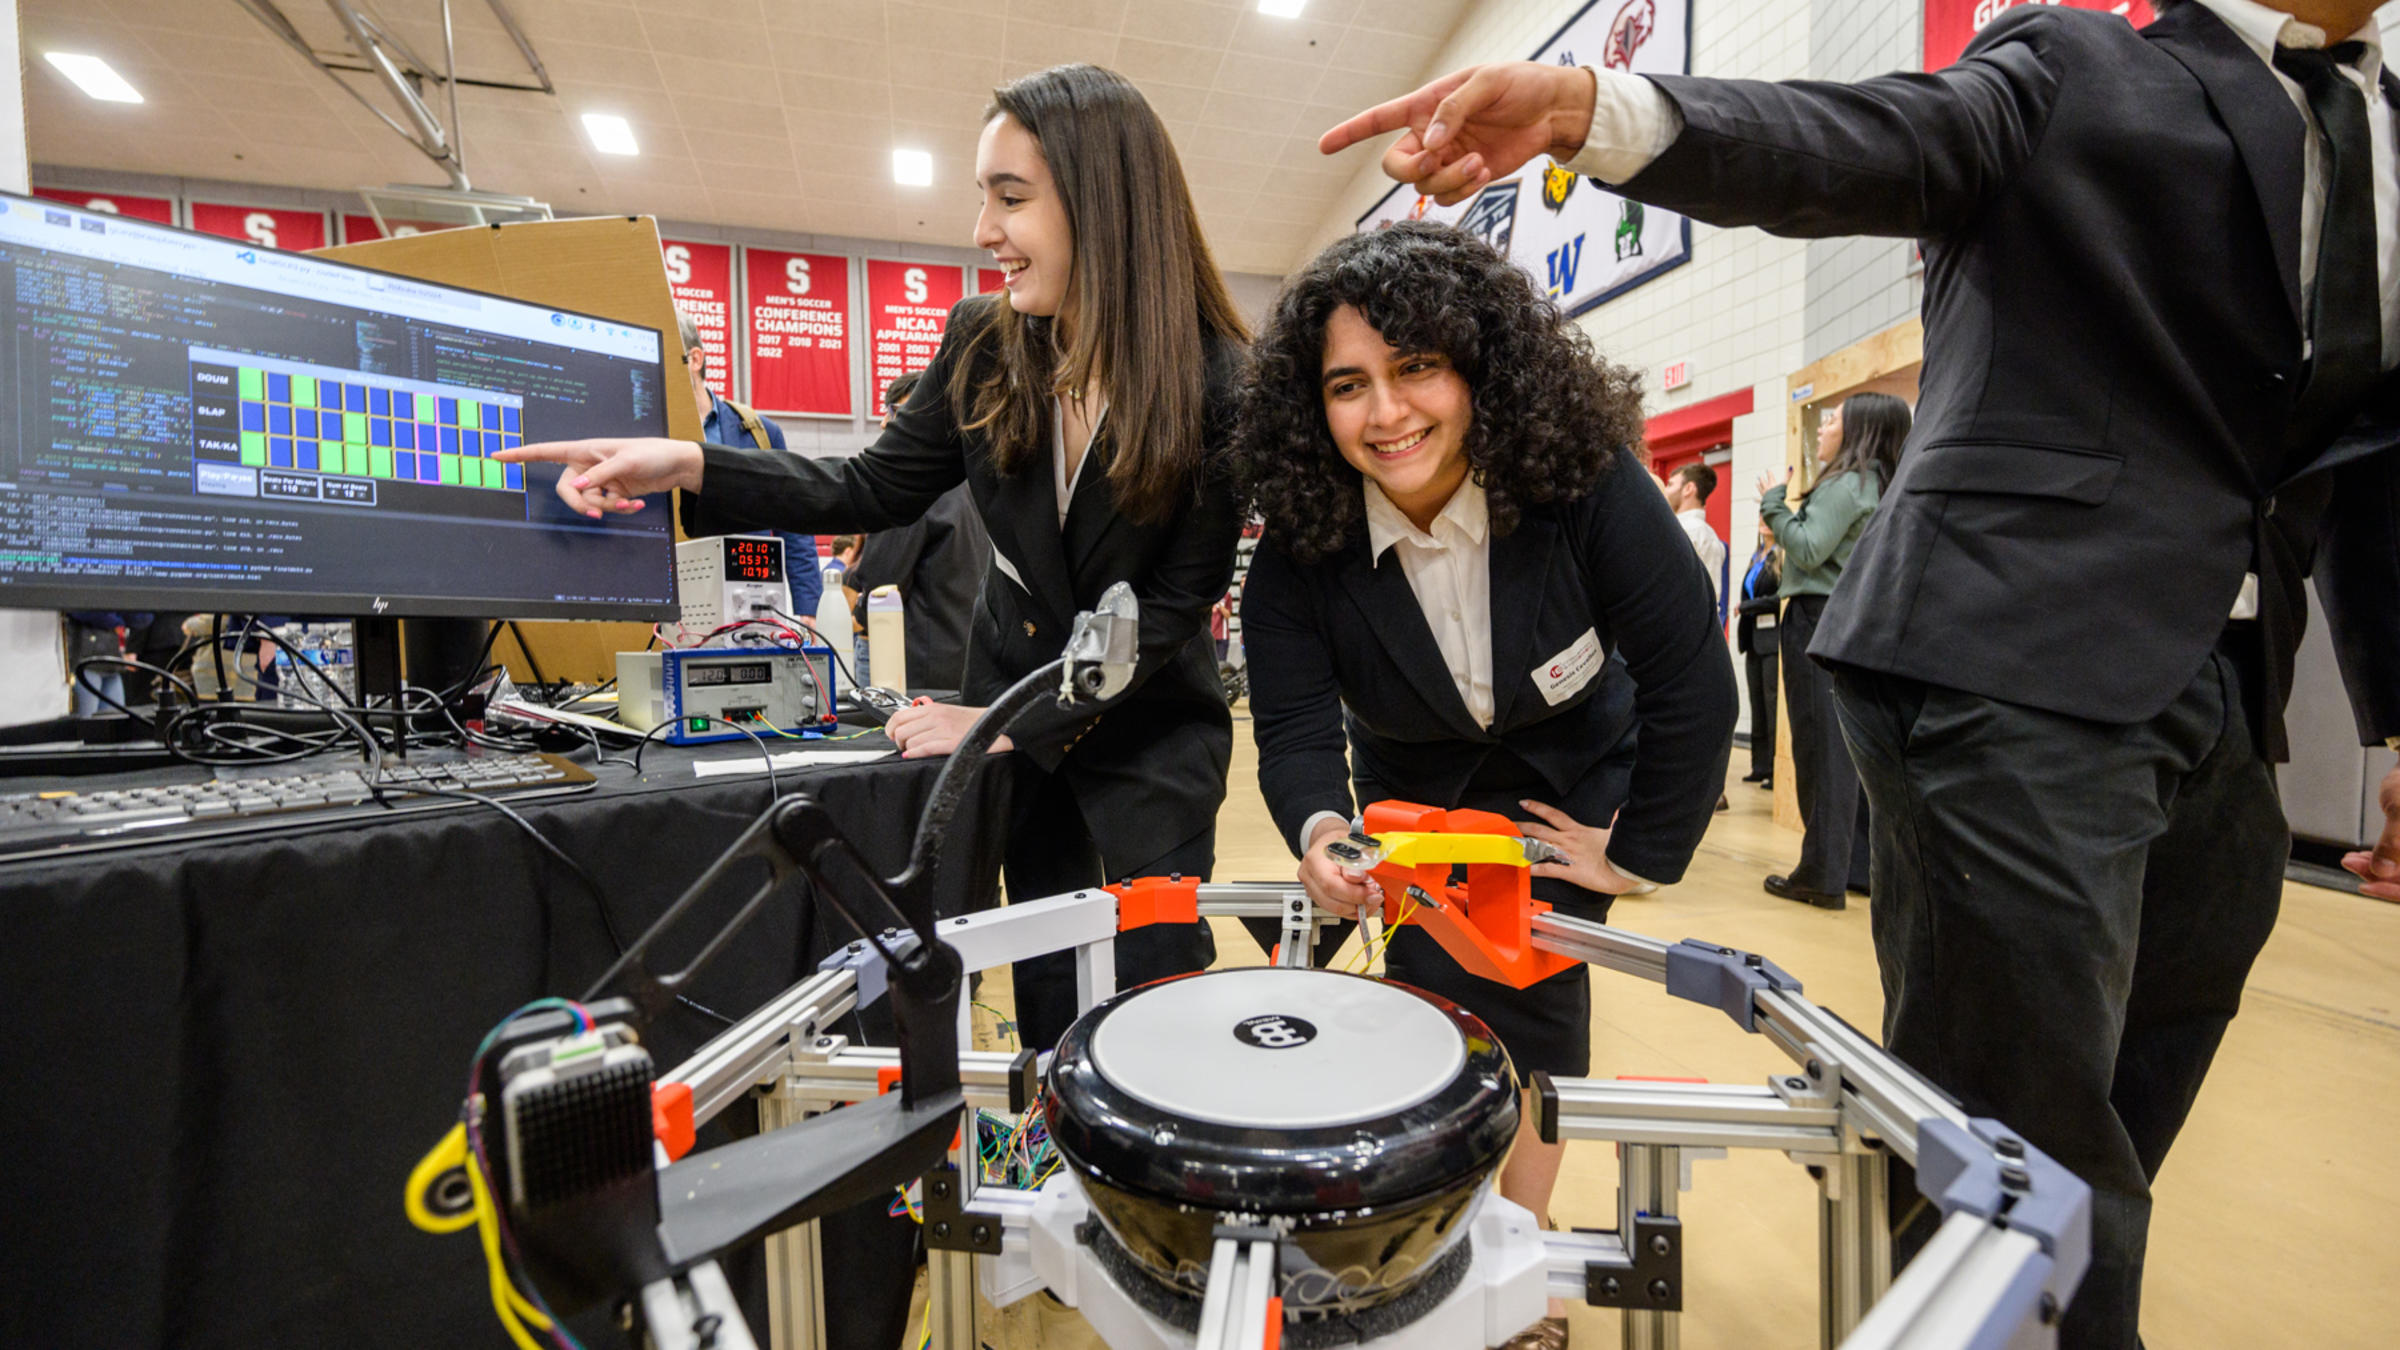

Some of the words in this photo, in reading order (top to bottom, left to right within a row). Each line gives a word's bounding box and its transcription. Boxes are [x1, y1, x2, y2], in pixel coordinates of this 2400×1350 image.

[665, 245, 691, 284] S
[786, 257, 811, 294] S
[676, 286, 714, 299] SOCCER
[904, 268, 928, 304] S
[765, 295, 796, 306] MEN'S
[797, 297, 832, 309] SOCCER
[755, 306, 843, 324] CONFERENCE
[885, 305, 913, 316] MEN'S
[915, 307, 948, 317] SOCCER
[755, 319, 843, 337] CHAMPIONS
[896, 317, 938, 332] NCAA
[757, 333, 781, 346] 2017
[788, 335, 812, 347] 2018
[819, 338, 842, 349] 2021
[878, 342, 901, 353] 2001
[757, 346, 782, 358] 2022
[705, 356, 726, 367] 006
[196, 371, 229, 385] DOUM
[704, 368, 727, 380] 009
[1664, 362, 1686, 389] EXIT
[199, 440, 239, 452] TAK/KA
